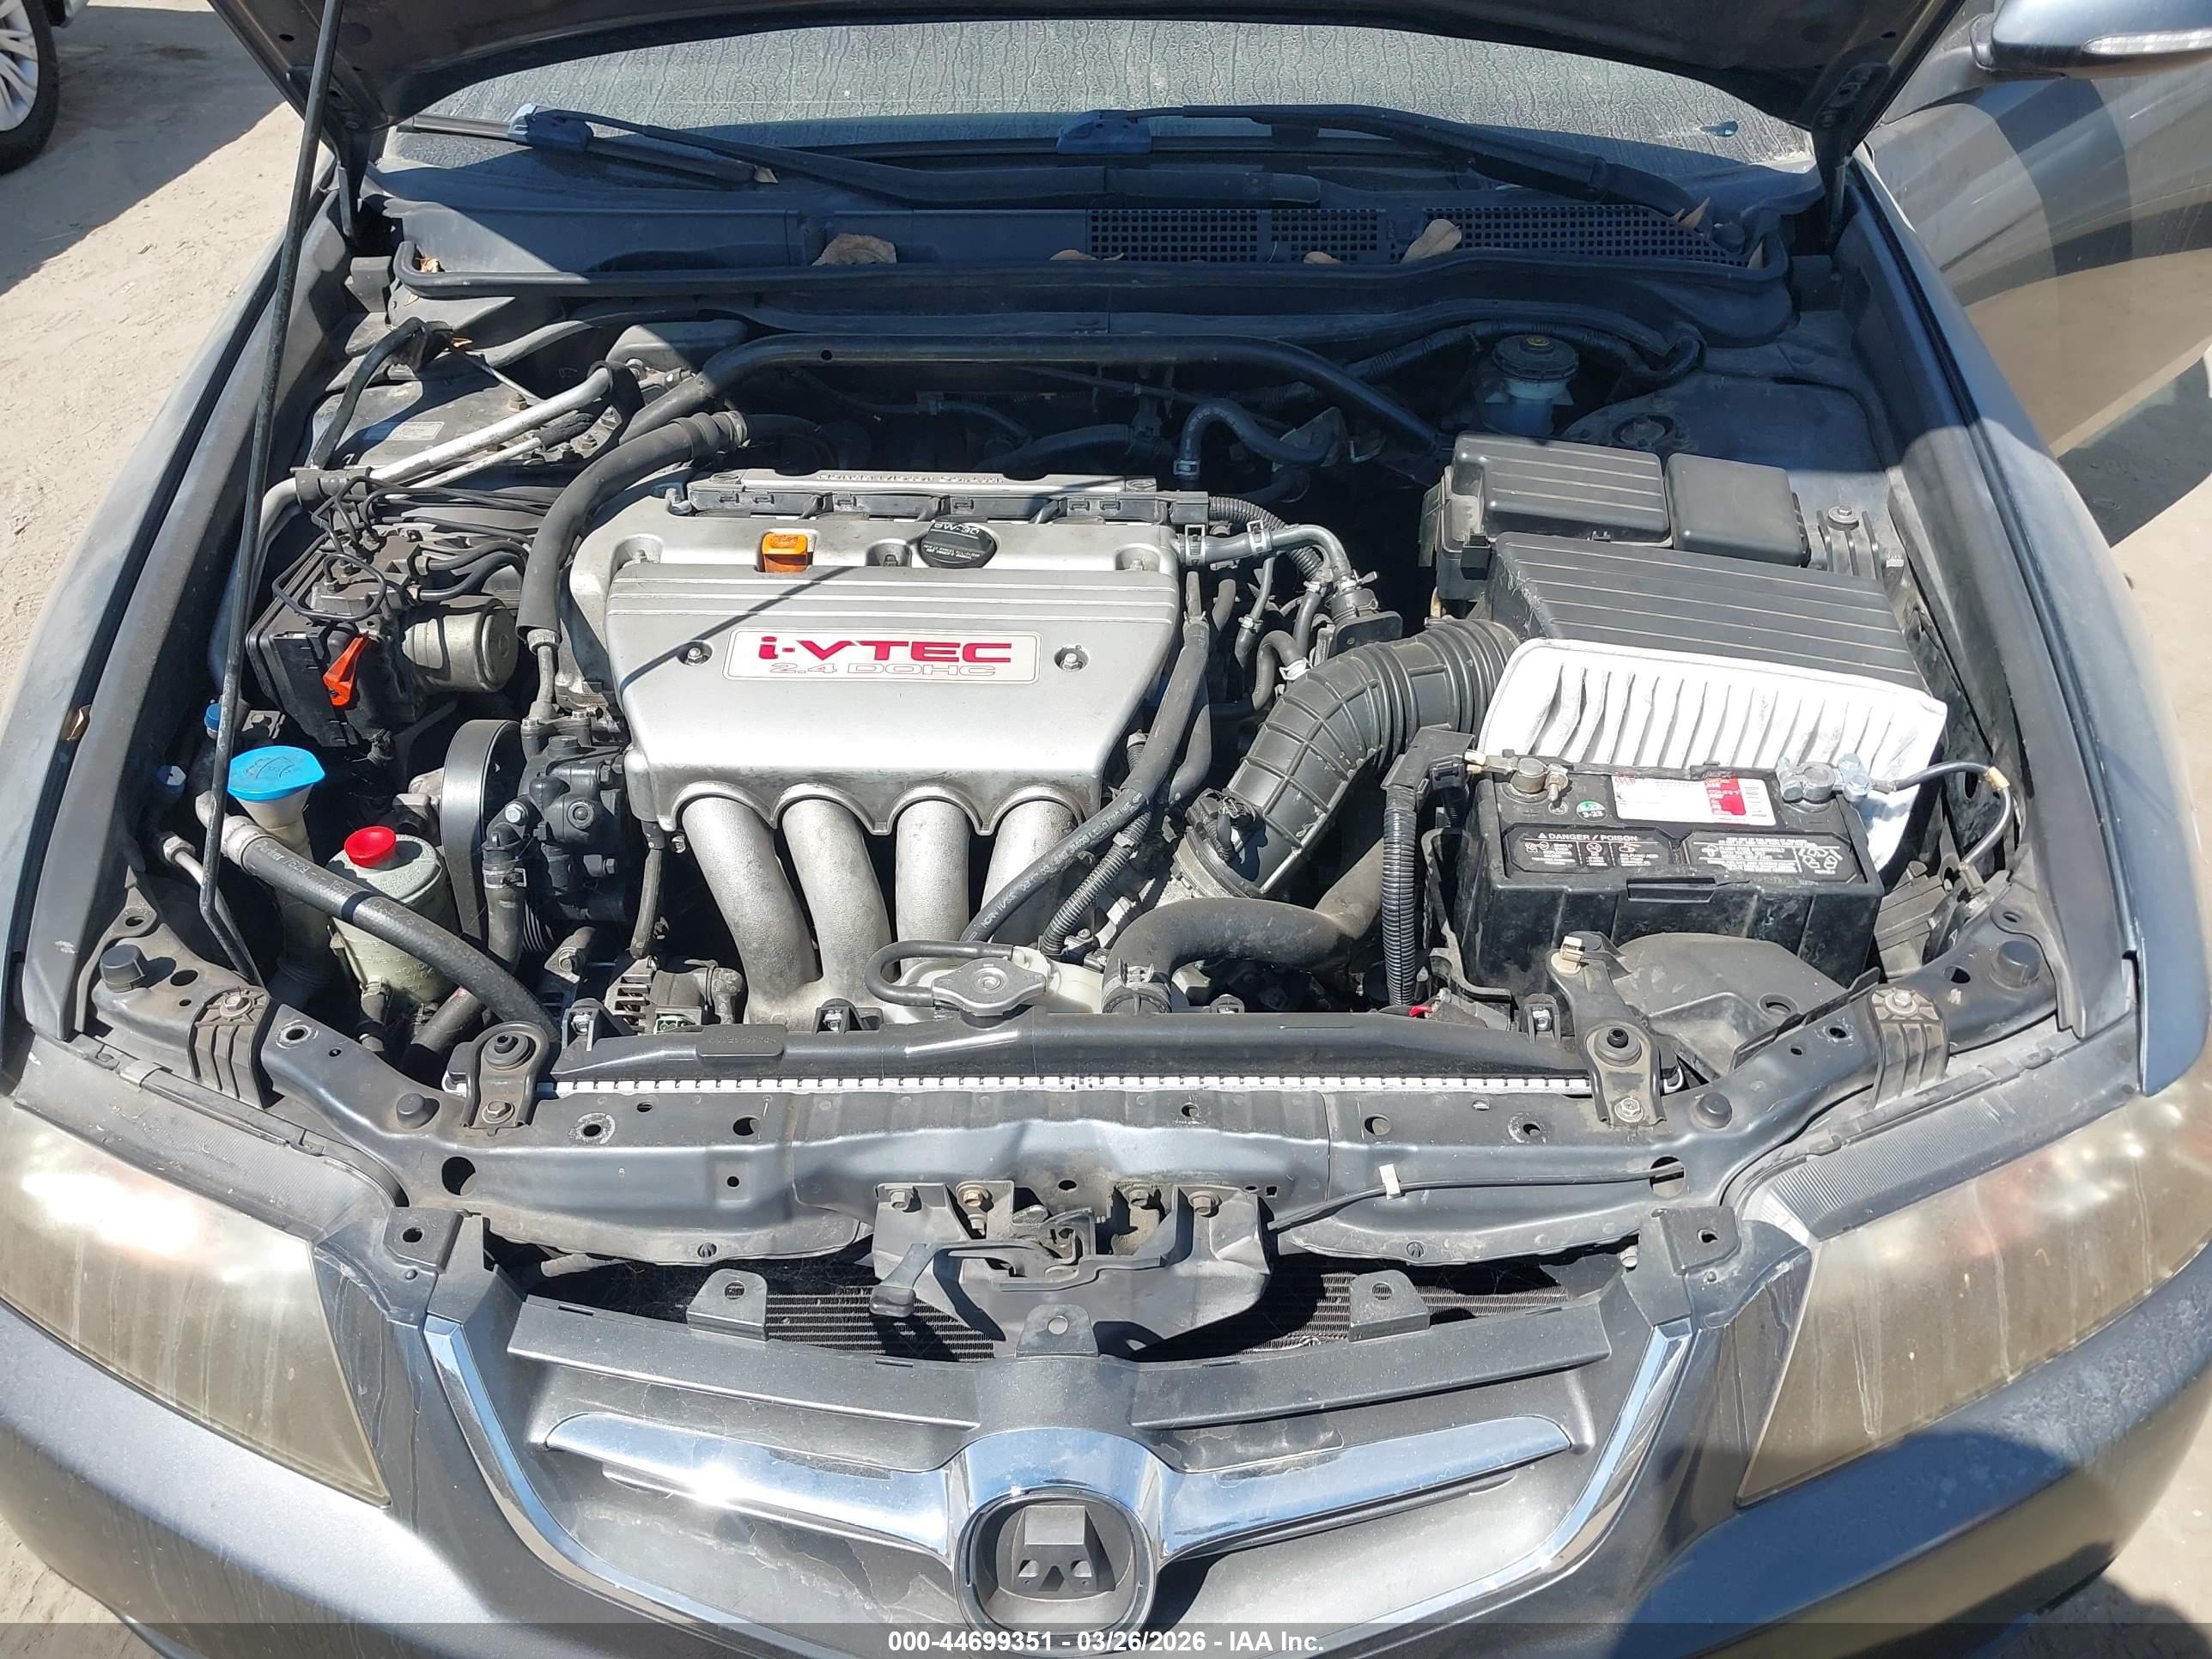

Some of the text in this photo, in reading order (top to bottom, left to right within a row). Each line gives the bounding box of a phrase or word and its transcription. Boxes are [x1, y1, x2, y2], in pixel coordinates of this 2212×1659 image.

[758, 636, 1012, 663] i-VTEC
[769, 662, 997, 676] 2.4 DOHC
